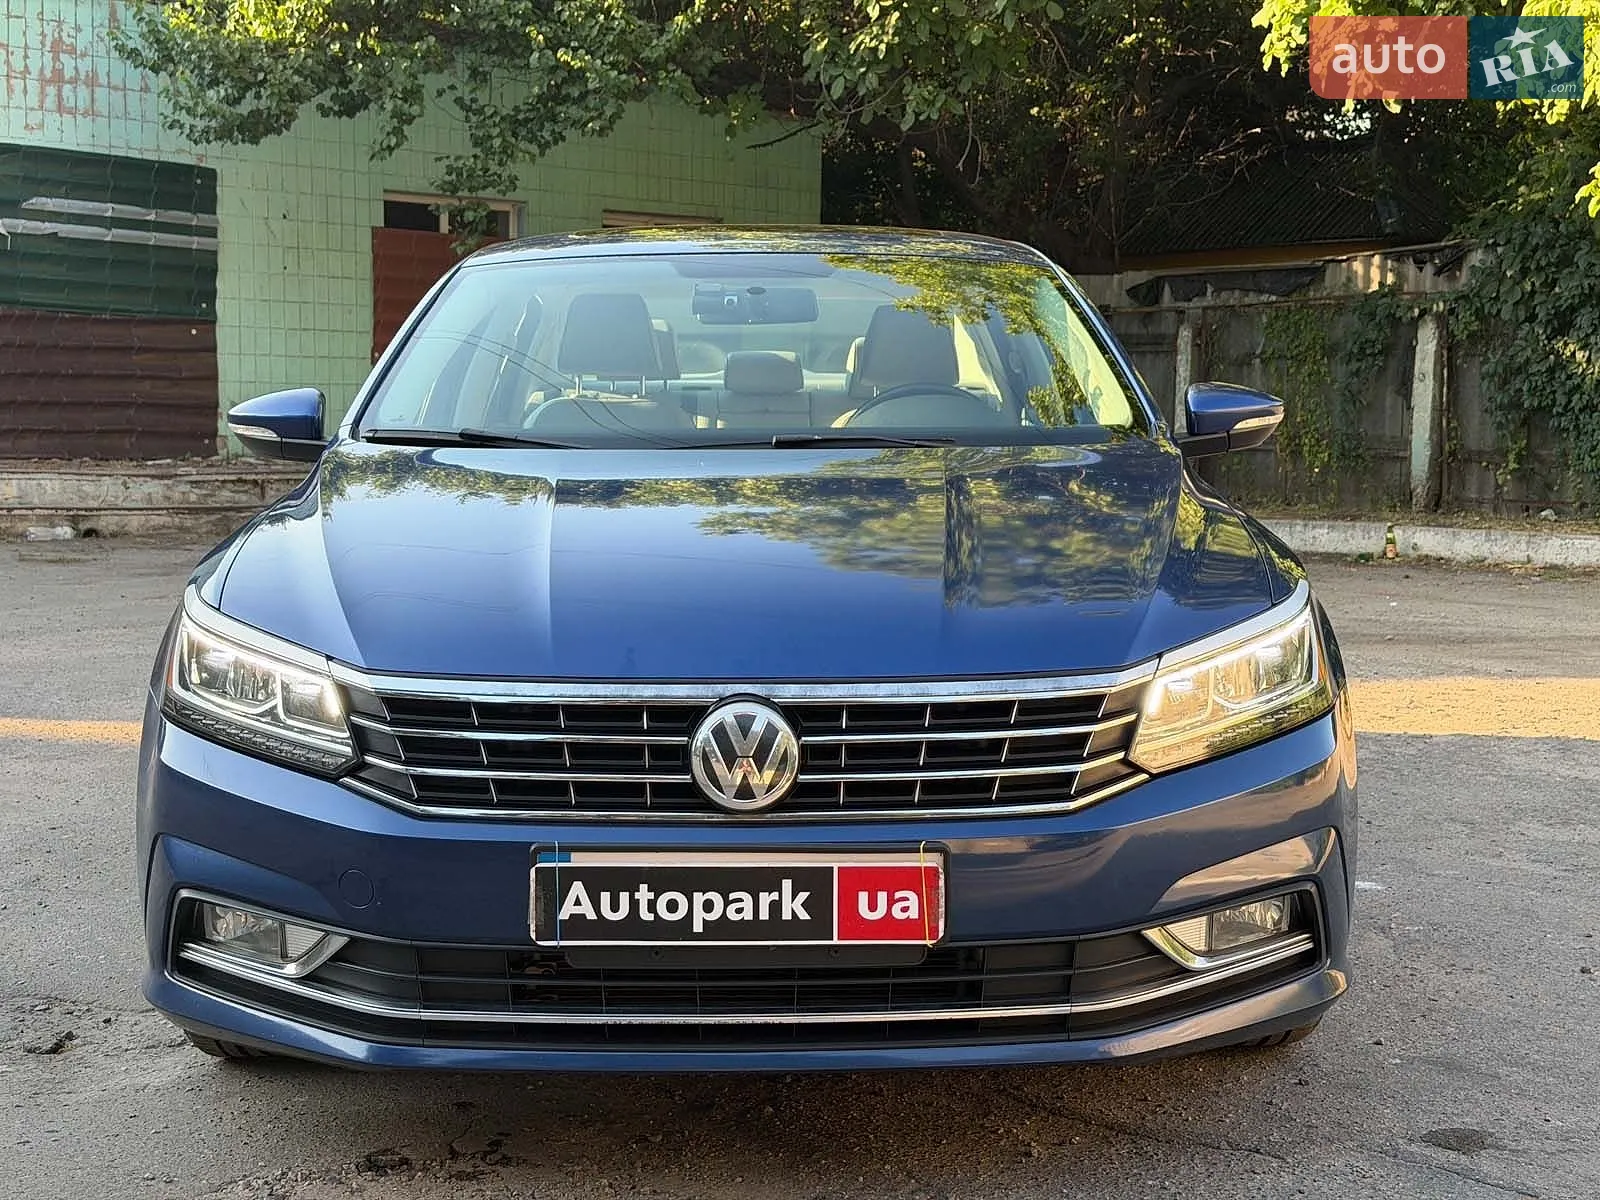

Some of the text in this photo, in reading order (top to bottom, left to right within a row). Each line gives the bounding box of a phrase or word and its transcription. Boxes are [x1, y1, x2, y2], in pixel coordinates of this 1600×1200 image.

[695, 706, 794, 806] VW
[558, 879, 920, 933] Autopark ua
